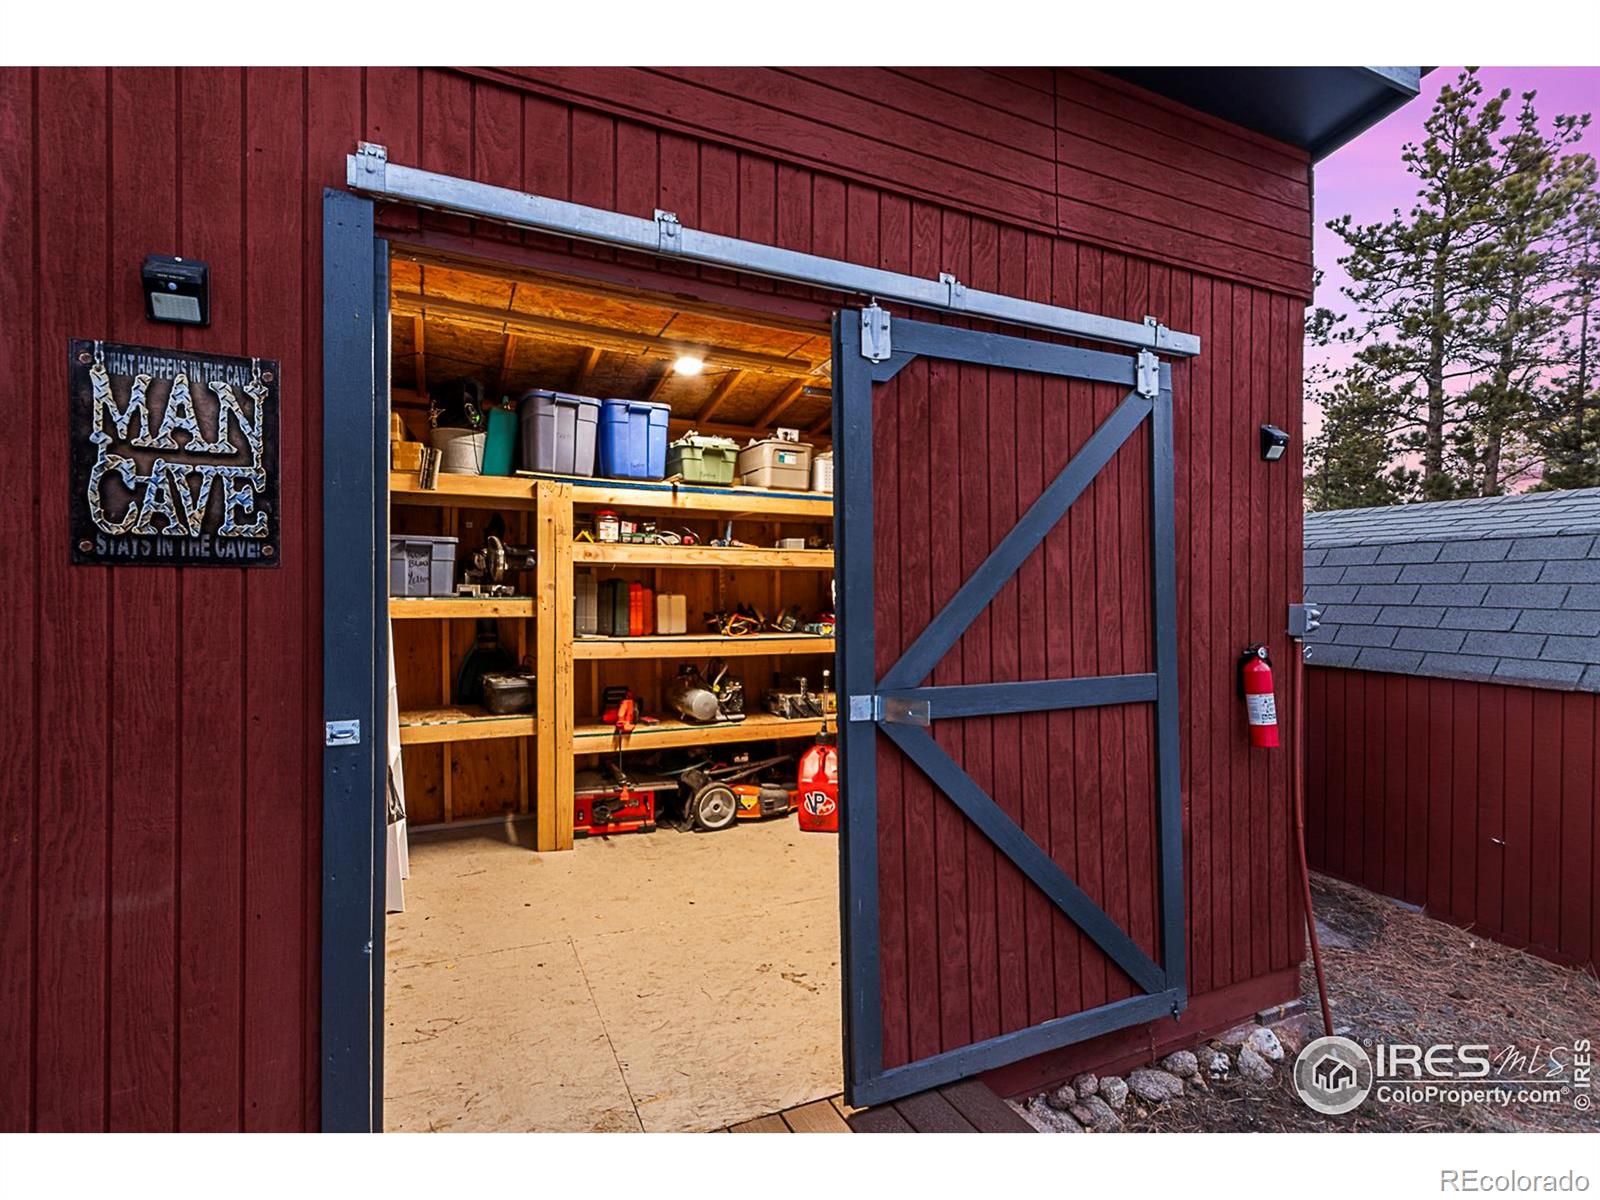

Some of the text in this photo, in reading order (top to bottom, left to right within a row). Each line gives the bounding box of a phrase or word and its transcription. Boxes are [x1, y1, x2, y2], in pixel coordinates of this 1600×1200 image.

[138, 355, 187, 381] HAPPENS
[190, 363, 201, 382] IN
[202, 363, 223, 384] THE
[90, 363, 268, 454] MAN
[87, 456, 269, 538] CAVE
[95, 533, 151, 559] STAYS
[156, 535, 174, 557] IN
[180, 534, 211, 558] THE
